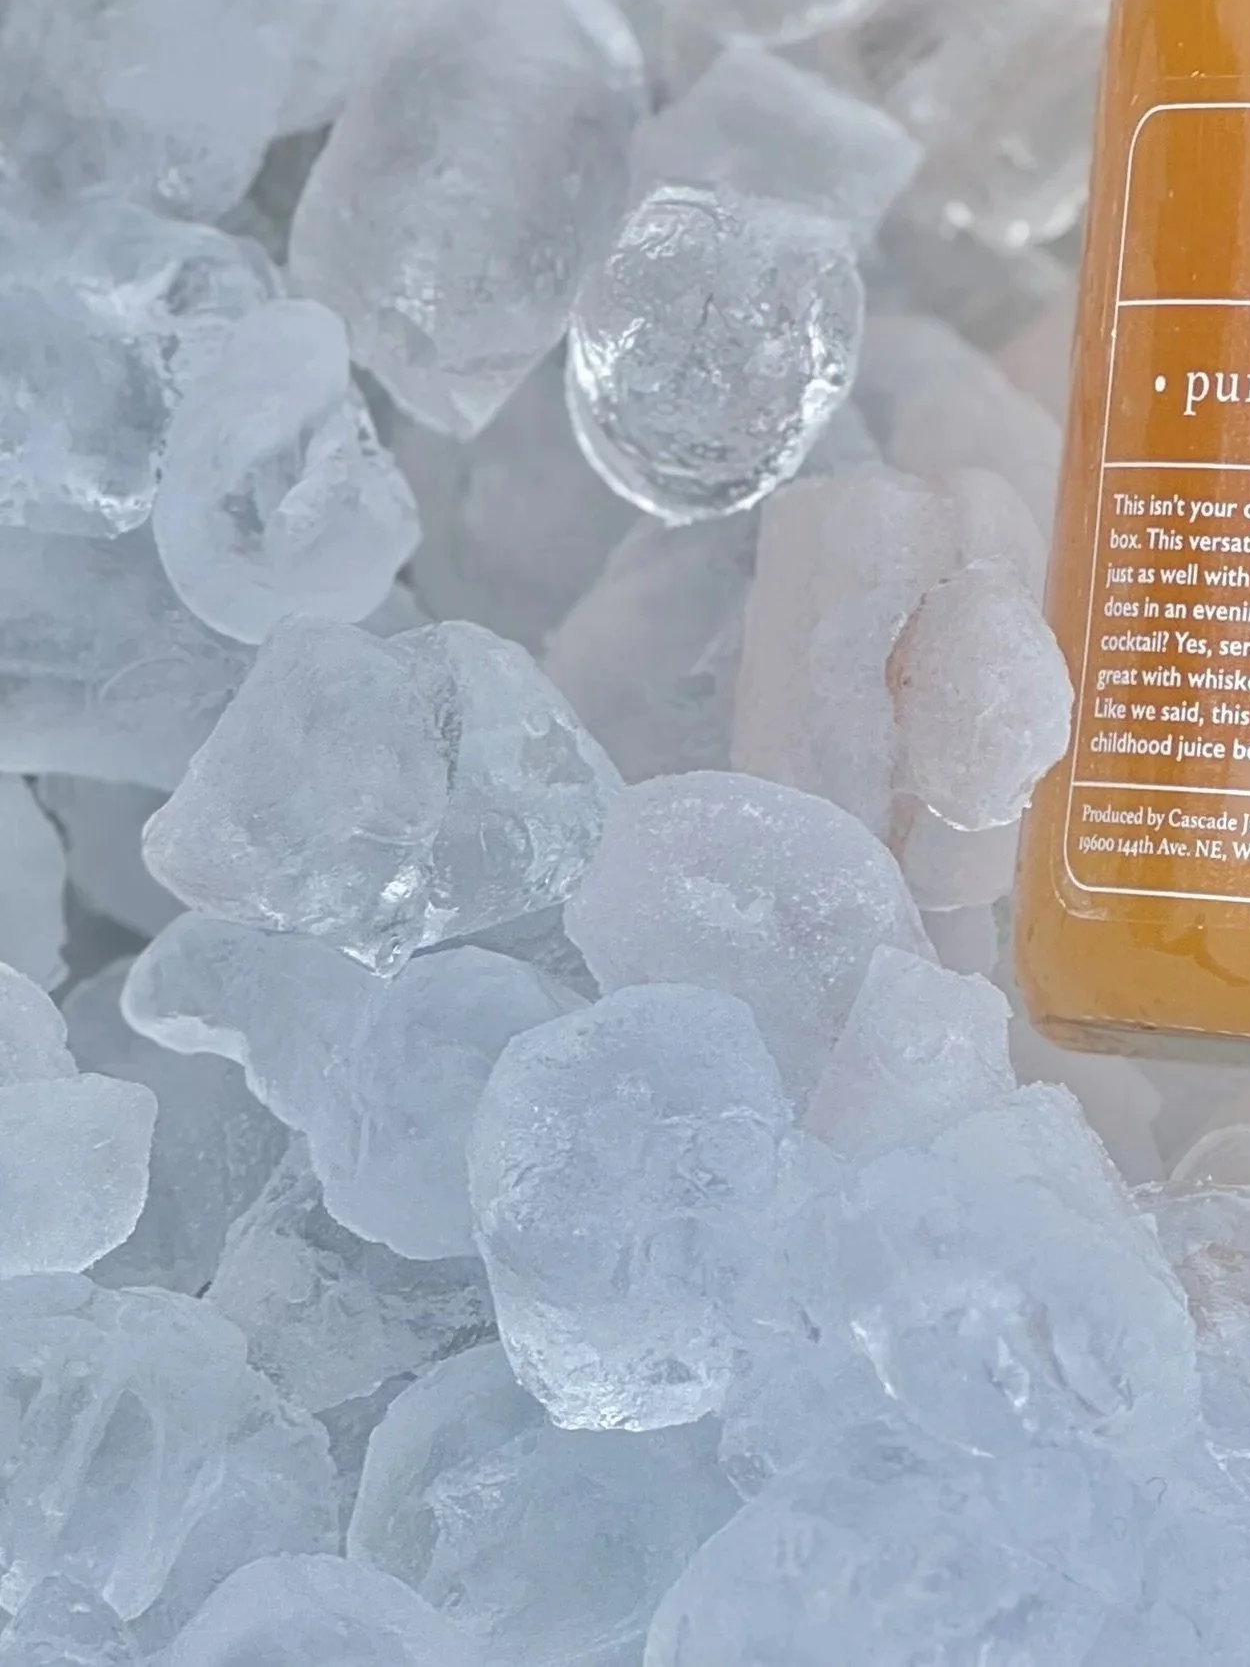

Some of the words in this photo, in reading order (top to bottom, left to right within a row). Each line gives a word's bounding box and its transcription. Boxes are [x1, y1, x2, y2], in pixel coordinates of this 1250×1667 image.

[1113, 493, 1145, 516] This
[1149, 494, 1186, 517] isn't
[1189, 501, 1238, 523] your
[1109, 528, 1142, 550] box.
[1146, 528, 1183, 551] This
[1106, 566, 1134, 588] just
[1137, 568, 1155, 584] as
[1160, 563, 1198, 585] well
[1204, 565, 1250, 587] with
[1104, 596, 1140, 618] does
[1143, 598, 1160, 618] in
[1164, 603, 1187, 619] an
[1100, 631, 1170, 653] cocktail?
[1175, 631, 1212, 658] Yes,
[1096, 668, 1138, 691] great
[1142, 666, 1182, 687] with
[1094, 697, 1127, 719] Like
[1131, 704, 1156, 721] we
[1160, 702, 1204, 727] said,
[1212, 702, 1250, 726] this
[1090, 732, 1173, 756] childhood
[1176, 735, 1226, 762] juice
[1082, 804, 1144, 825] Produced
[1146, 806, 1166, 830] by
[1168, 808, 1238, 831] Cascade
[1078, 834, 1116, 854] 19600
[1116, 835, 1154, 857] 144th
[1156, 837, 1191, 857] Ave.
[1194, 840, 1227, 862] NE,
